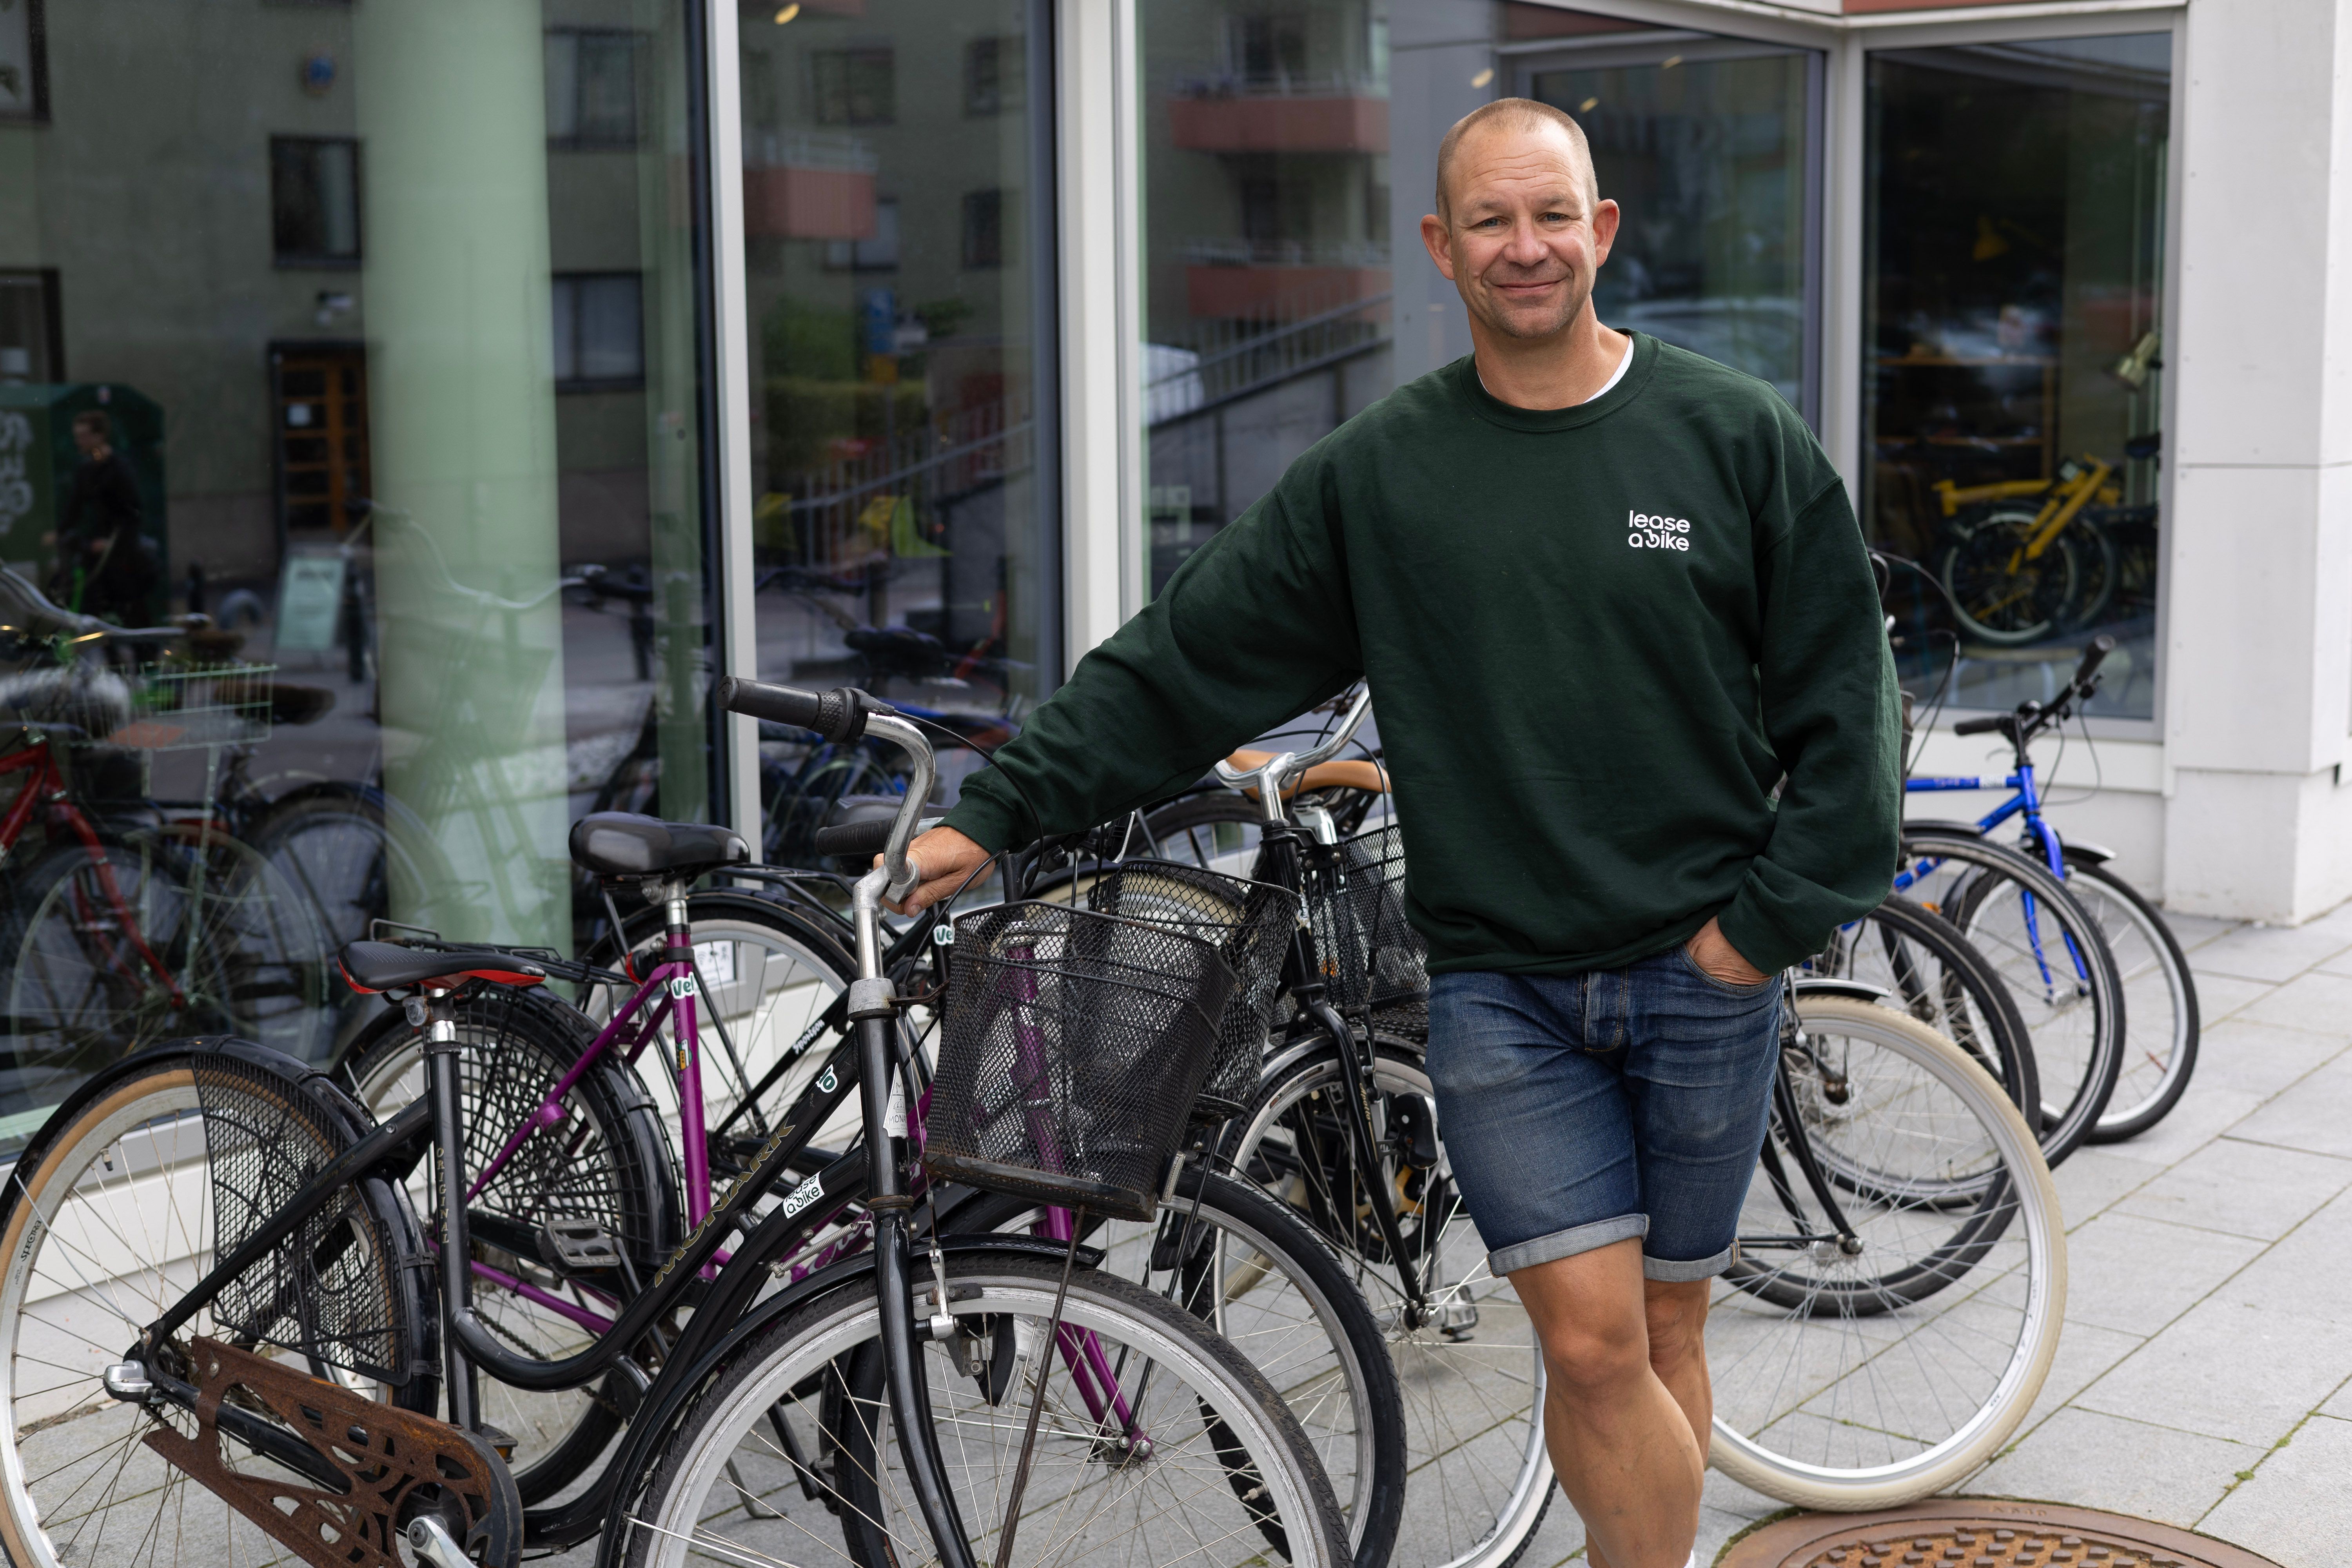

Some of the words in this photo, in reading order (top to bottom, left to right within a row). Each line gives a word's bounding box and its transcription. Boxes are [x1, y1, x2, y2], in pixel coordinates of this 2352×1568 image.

[1629, 510, 1690, 533] lease
[1628, 533, 1643, 548] a
[1643, 529, 1690, 551] bike
[673, 975, 695, 996] Vel
[888, 1114, 907, 1125] MONA
[436, 1147, 450, 1244] ORIGINAL
[654, 1115, 796, 1288] MONARK
[787, 1203, 797, 1214] a
[793, 1186, 820, 1208] bike
